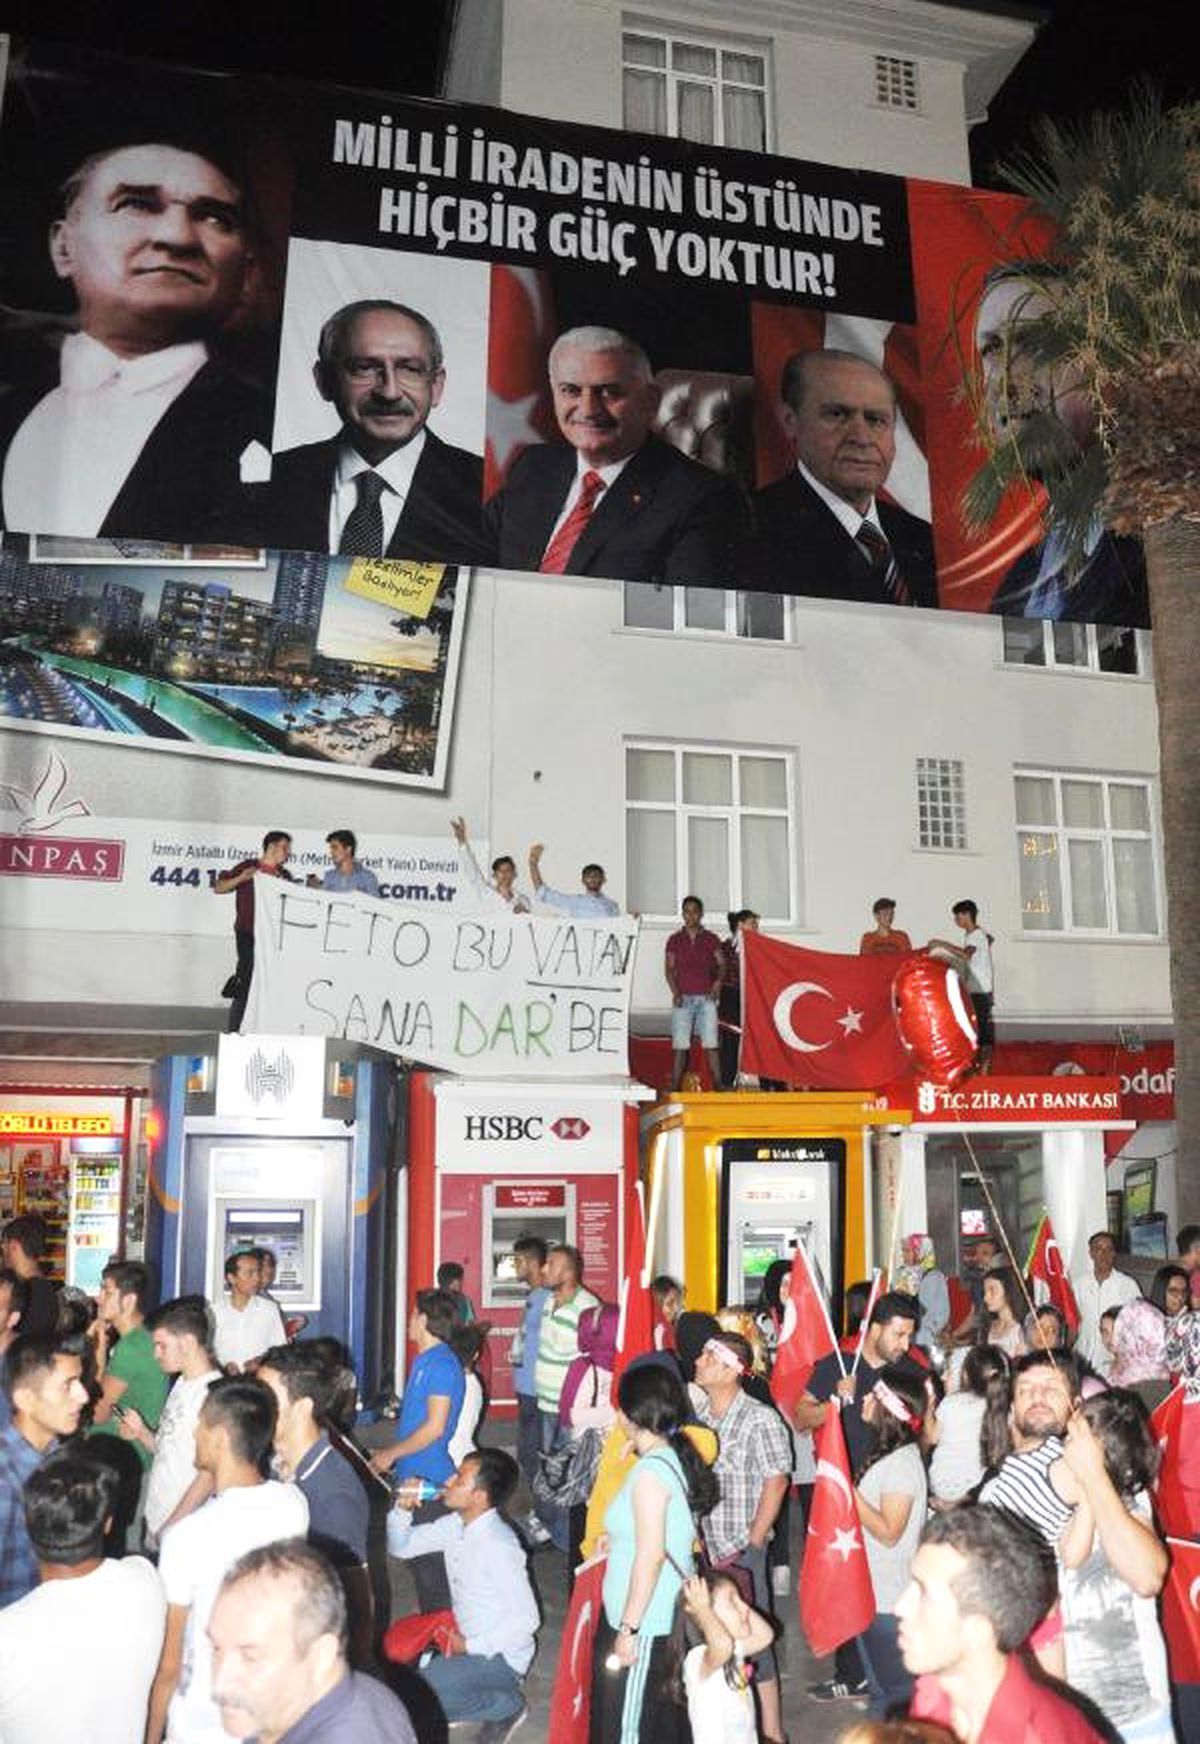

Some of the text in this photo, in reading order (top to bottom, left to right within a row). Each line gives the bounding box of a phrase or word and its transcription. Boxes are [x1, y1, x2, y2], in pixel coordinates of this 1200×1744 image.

[332, 115, 885, 247] MİLLİ İRADENİN ÜSTÜNDE
[378, 181, 838, 297] HİÇBİR GÜÇ YOKTUR!
[149, 865, 201, 888] 444
[377, 882, 457, 902] com.tr
[419, 859, 459, 874] Denizli
[278, 893, 637, 977] FETO BU VATAN
[304, 979, 434, 1050] SANA
[971, 1089, 1038, 1109] ZİRAAT
[1042, 1092, 1118, 1109] BANKASI
[464, 1115, 544, 1141] HSBC
